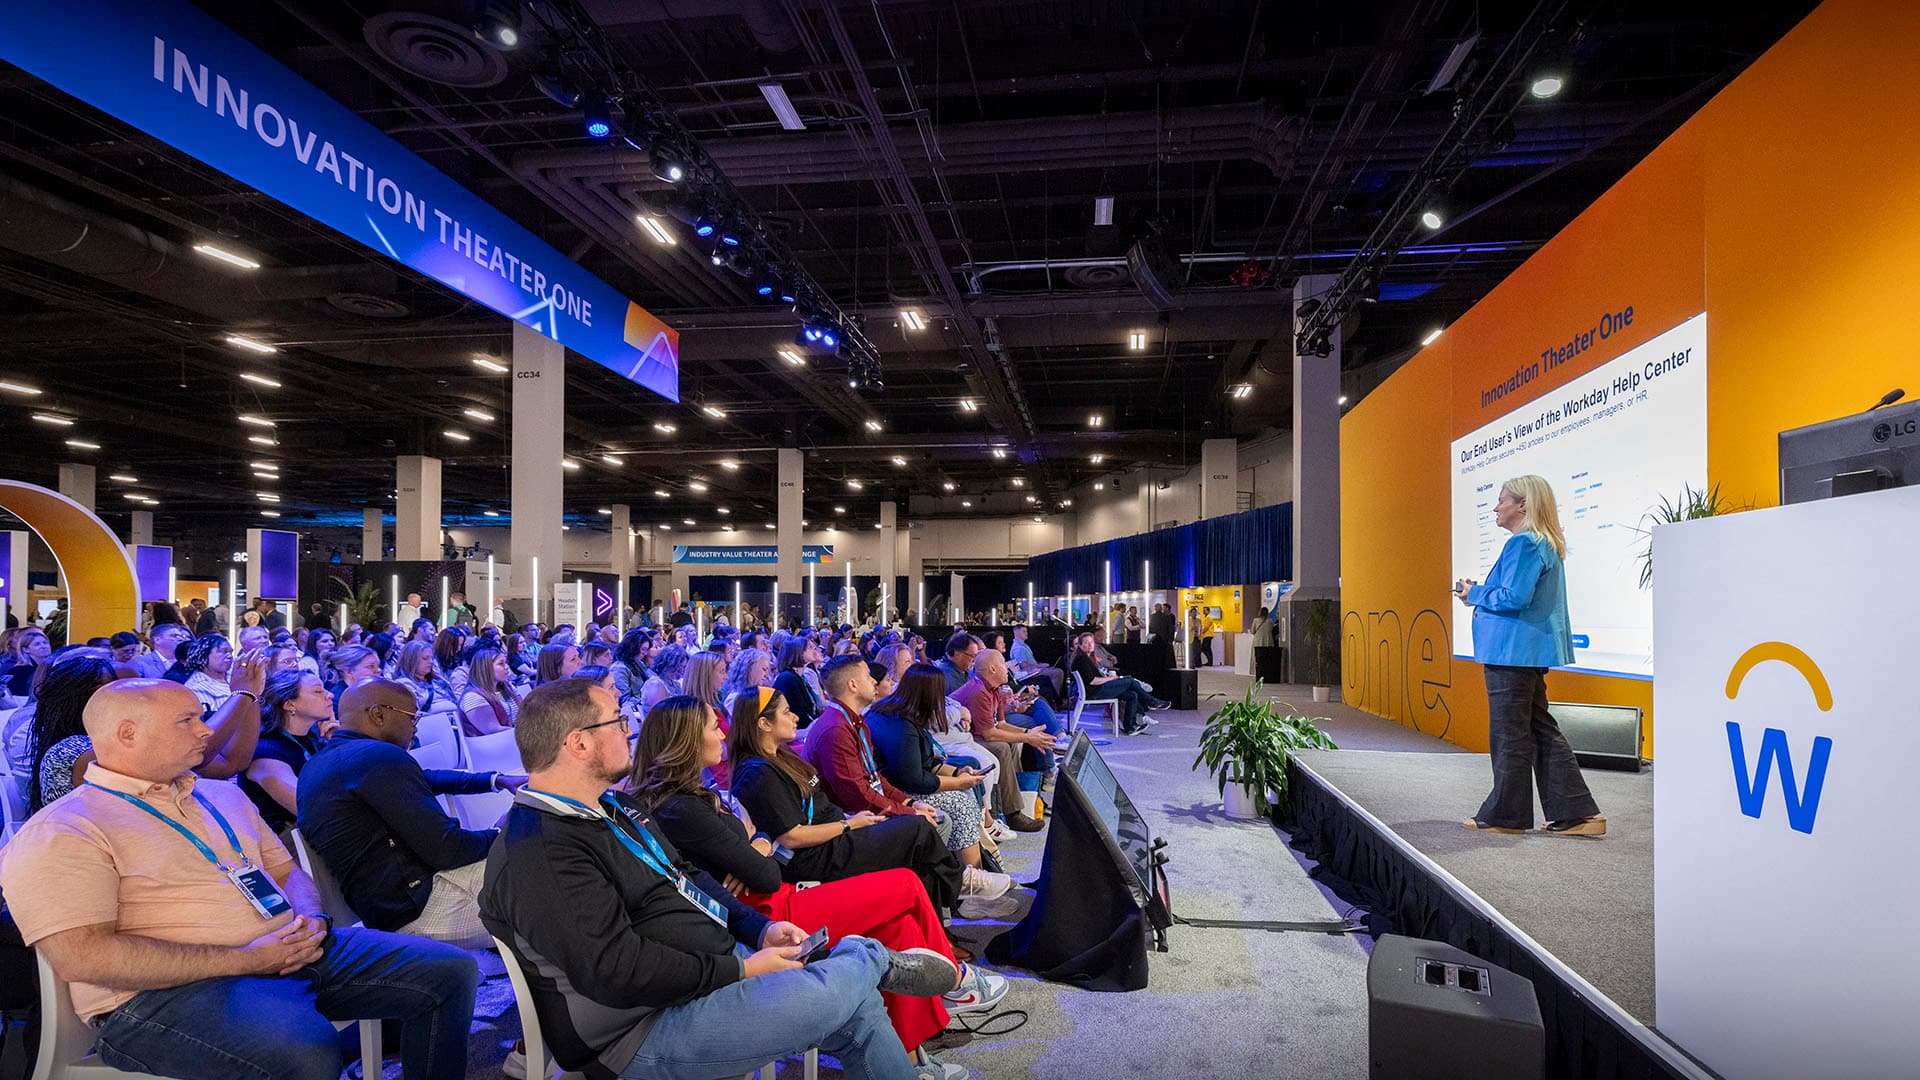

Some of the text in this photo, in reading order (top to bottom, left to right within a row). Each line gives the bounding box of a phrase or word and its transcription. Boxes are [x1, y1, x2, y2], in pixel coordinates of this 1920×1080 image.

[153, 35, 592, 327] INNOVATION THEATER ONE
[517, 370, 541, 380] CC34
[1460, 346, 1693, 463] Our End User's View of the Workday Help Center
[1481, 305, 1634, 408] Innovation Theater One
[1627, 396, 1634, 407] or
[1636, 389, 1648, 404] HR
[1894, 420, 1916, 437] LG
[1341, 608, 1452, 739] one
[1725, 720, 1833, 835] W
